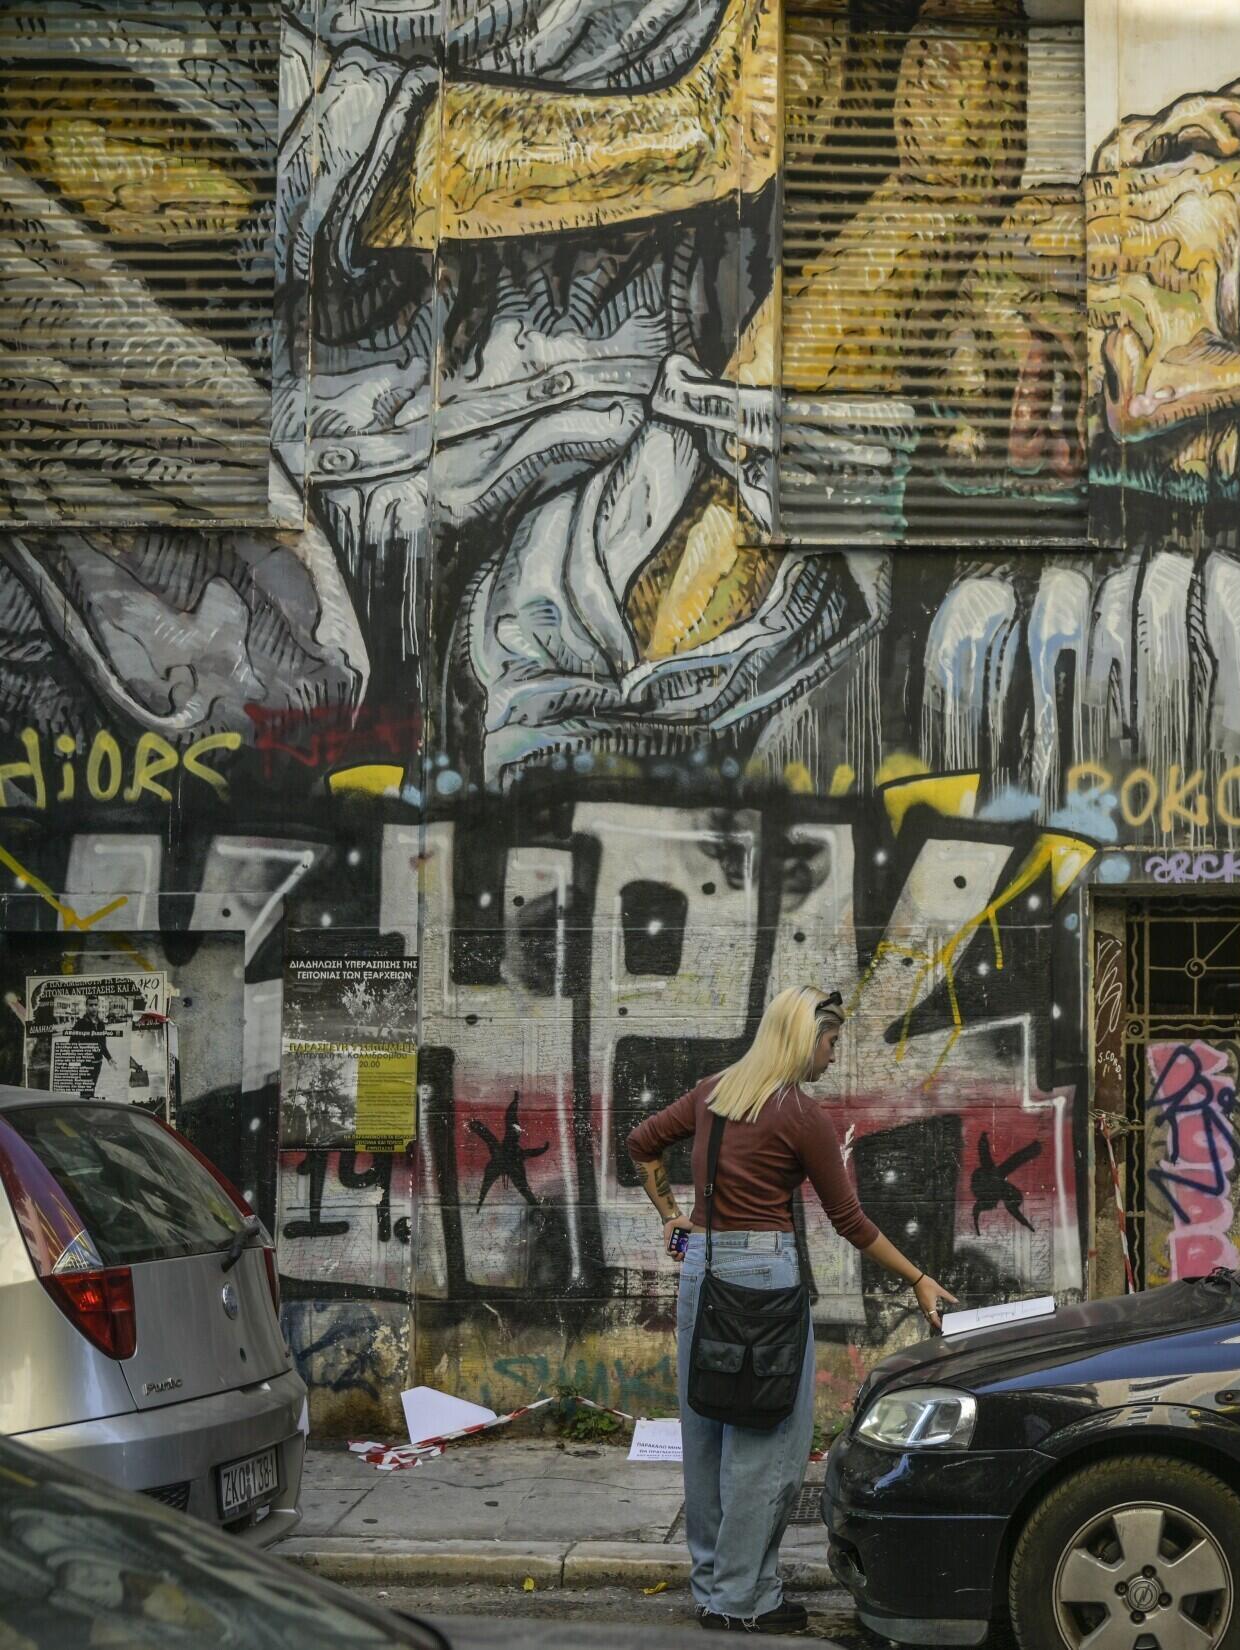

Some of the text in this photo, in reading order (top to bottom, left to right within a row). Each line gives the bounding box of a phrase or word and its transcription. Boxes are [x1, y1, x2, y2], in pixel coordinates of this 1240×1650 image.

[289, 960, 418, 969] ΔΙΑΔΗΛΩΣΗ ΥΠΕΡΑΣΠΙΣΗΣ ΤΗΣ
[297, 971, 412, 980] ΓΕΙΤΟΝΙΑΣ ΤΩΝ ΕΞΑΡΧΕΙΩΝ
[71, 984, 115, 996] ΑΝΤΙΣΤΑΣΗΣ
[117, 984, 130, 993] ΚΑΙ
